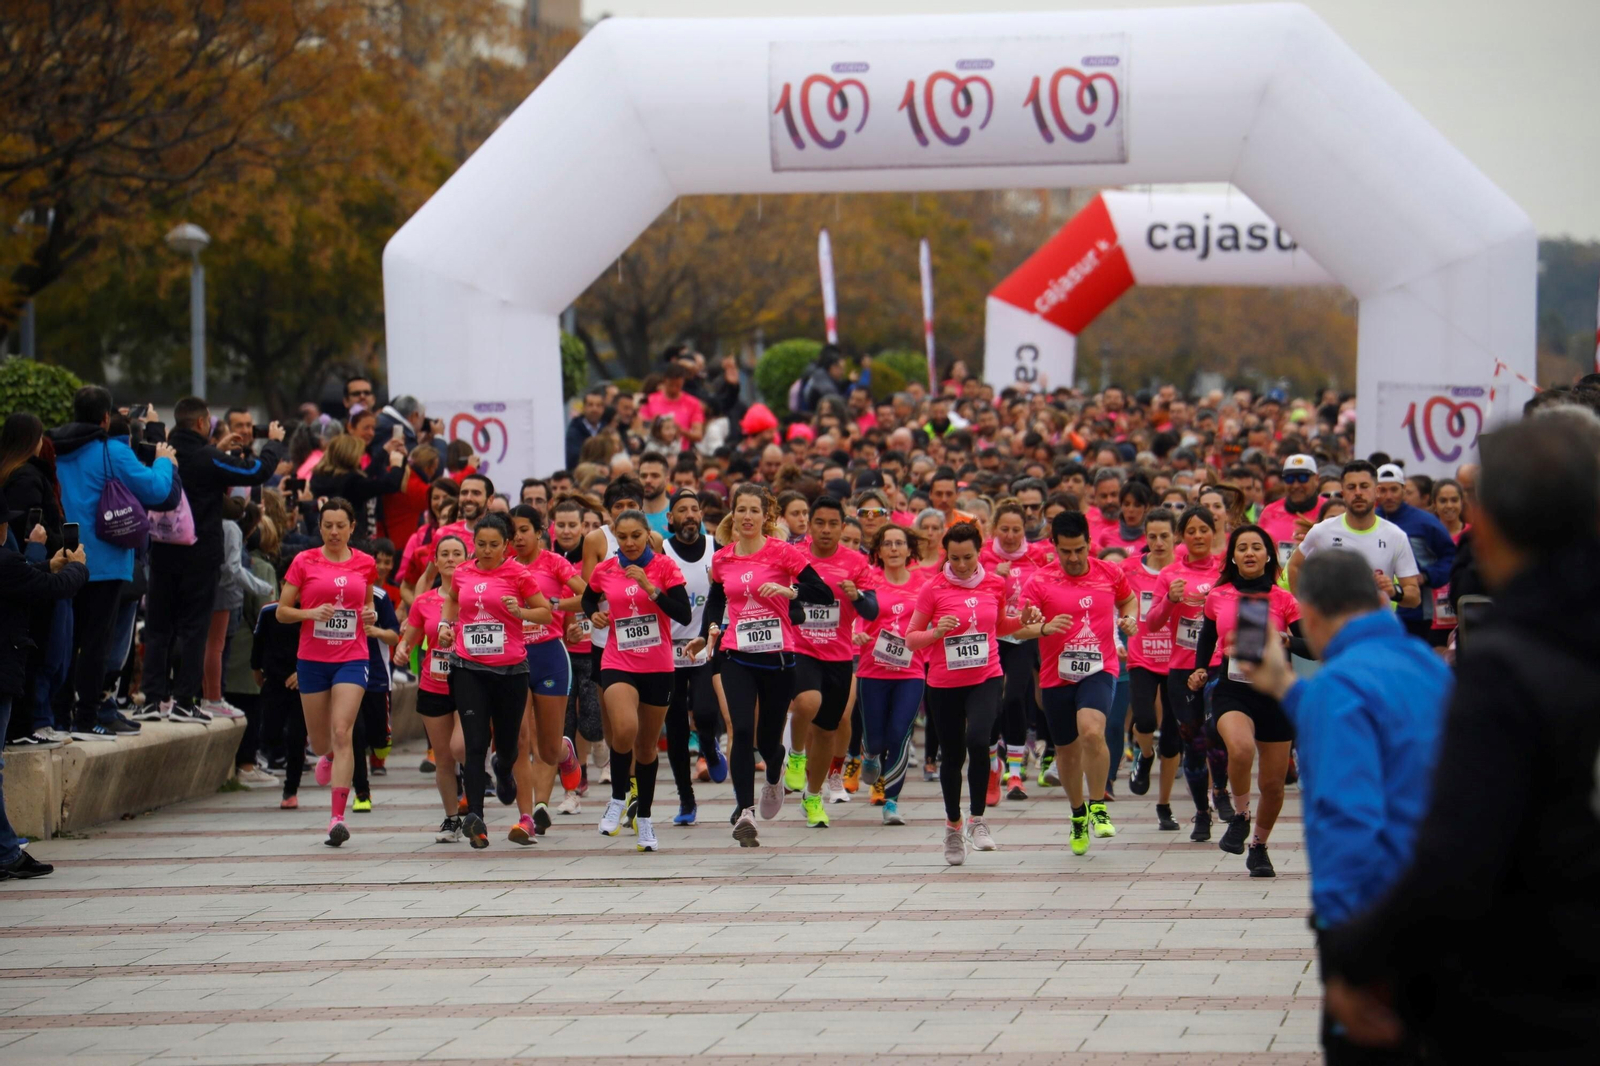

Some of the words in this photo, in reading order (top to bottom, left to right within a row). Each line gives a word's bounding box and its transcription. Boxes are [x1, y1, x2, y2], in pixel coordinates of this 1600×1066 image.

[808, 609, 830, 620] 1621
[325, 618, 348, 629] 1033
[625, 625, 650, 639] 1389
[747, 629, 772, 643] 1020
[471, 633, 493, 645] 1054
[885, 642, 904, 657] 839
[956, 644, 979, 657] 1419
[438, 660, 450, 671] 18
[1071, 660, 1091, 673] 640
